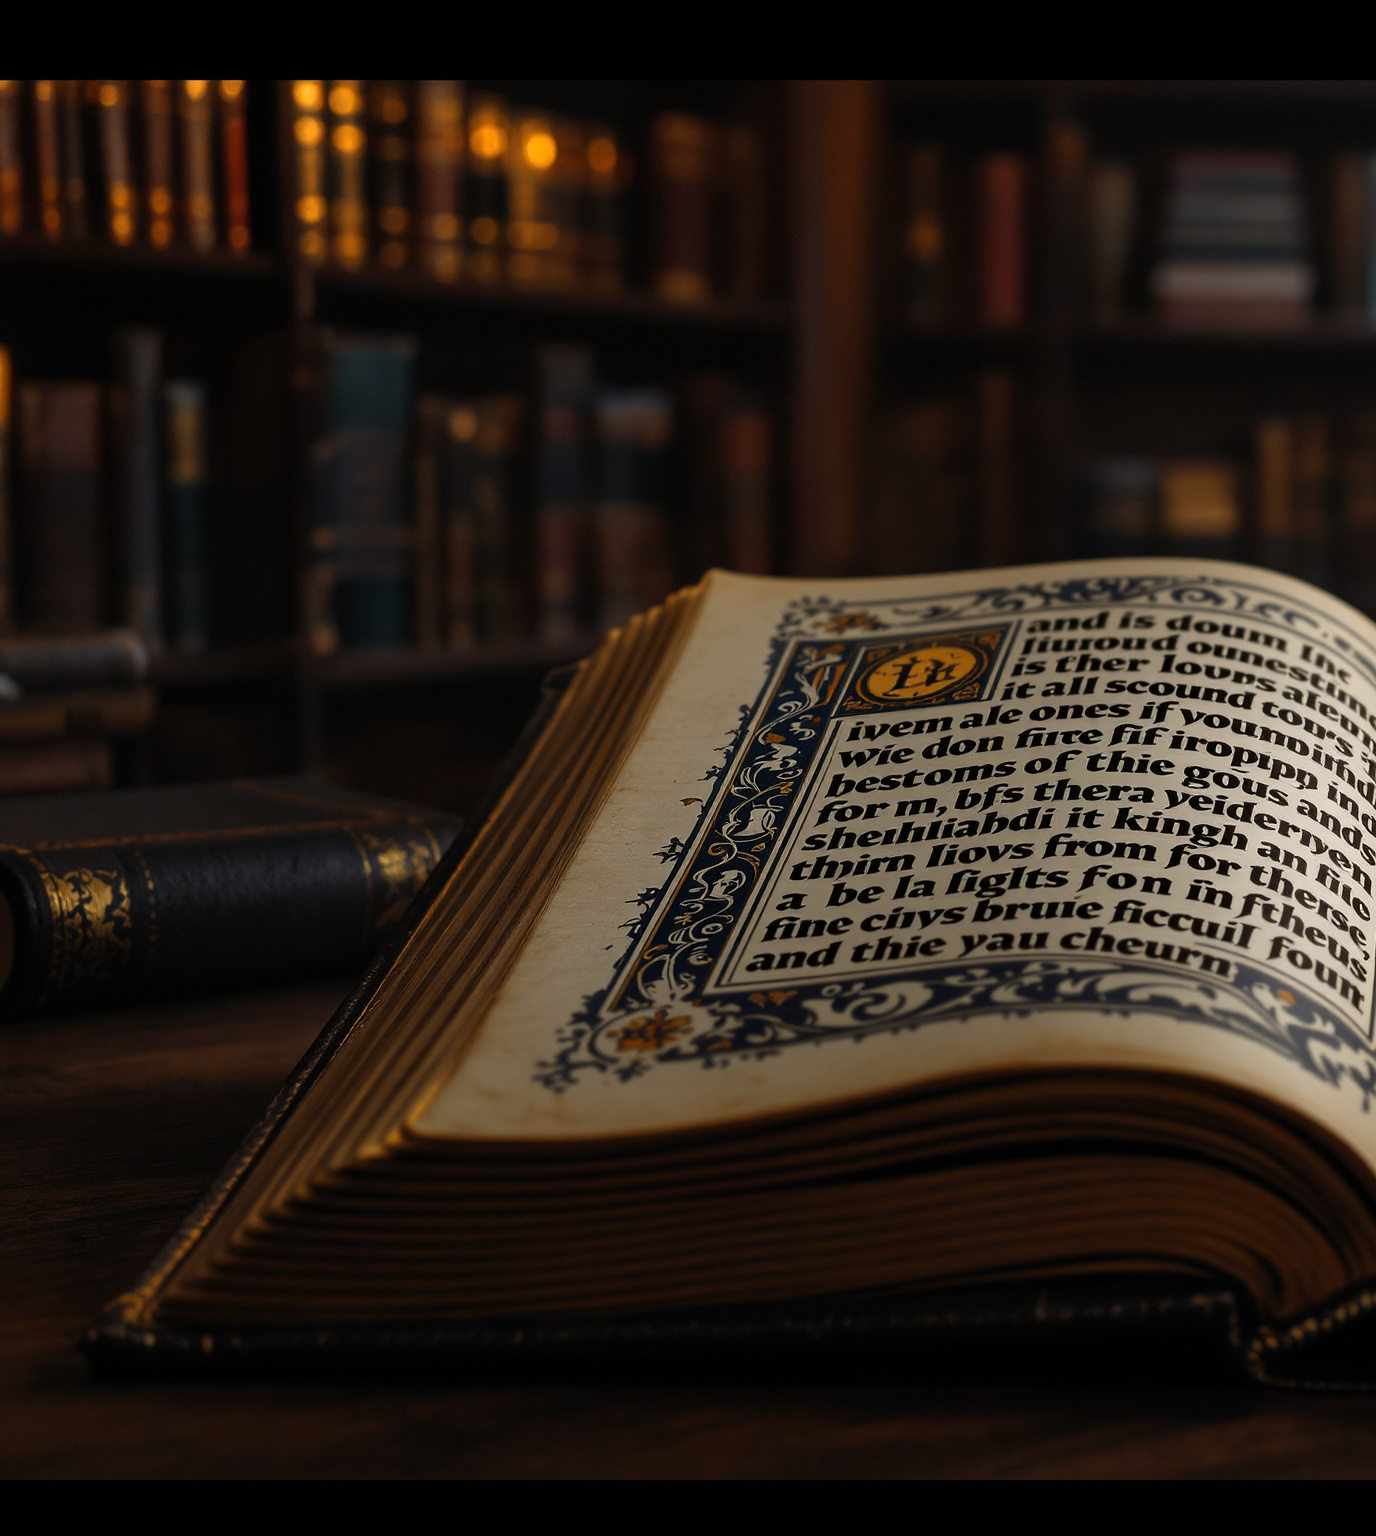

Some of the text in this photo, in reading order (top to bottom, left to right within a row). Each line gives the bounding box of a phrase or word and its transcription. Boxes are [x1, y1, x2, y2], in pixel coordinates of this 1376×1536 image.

[1026, 611, 1111, 633] and
[1118, 612, 1156, 630] is
[1011, 657, 1047, 677] is
[1055, 653, 1150, 673] ther
[1001, 681, 1043, 700] it
[1041, 676, 1099, 697] all
[959, 704, 1023, 729] ale
[1029, 703, 1131, 720] ones
[1139, 701, 1179, 724] if
[922, 735, 1003, 758] don
[813, 800, 891, 828] for
[893, 797, 947, 817] m,
[1033, 778, 1155, 803] thera
[824, 760, 1016, 798] bestoms
[1024, 749, 1083, 773] of
[1086, 750, 1176, 775] thie
[1297, 799, 1376, 866] ands
[1042, 833, 1157, 861] from
[1165, 843, 1241, 876] for
[1065, 807, 1104, 828] it
[1111, 806, 1248, 850] kingh
[1257, 841, 1307, 876] an
[776, 893, 808, 911] a
[826, 883, 885, 907] be
[761, 916, 853, 942] fine
[746, 941, 843, 972] and
[958, 932, 1050, 957] yau
